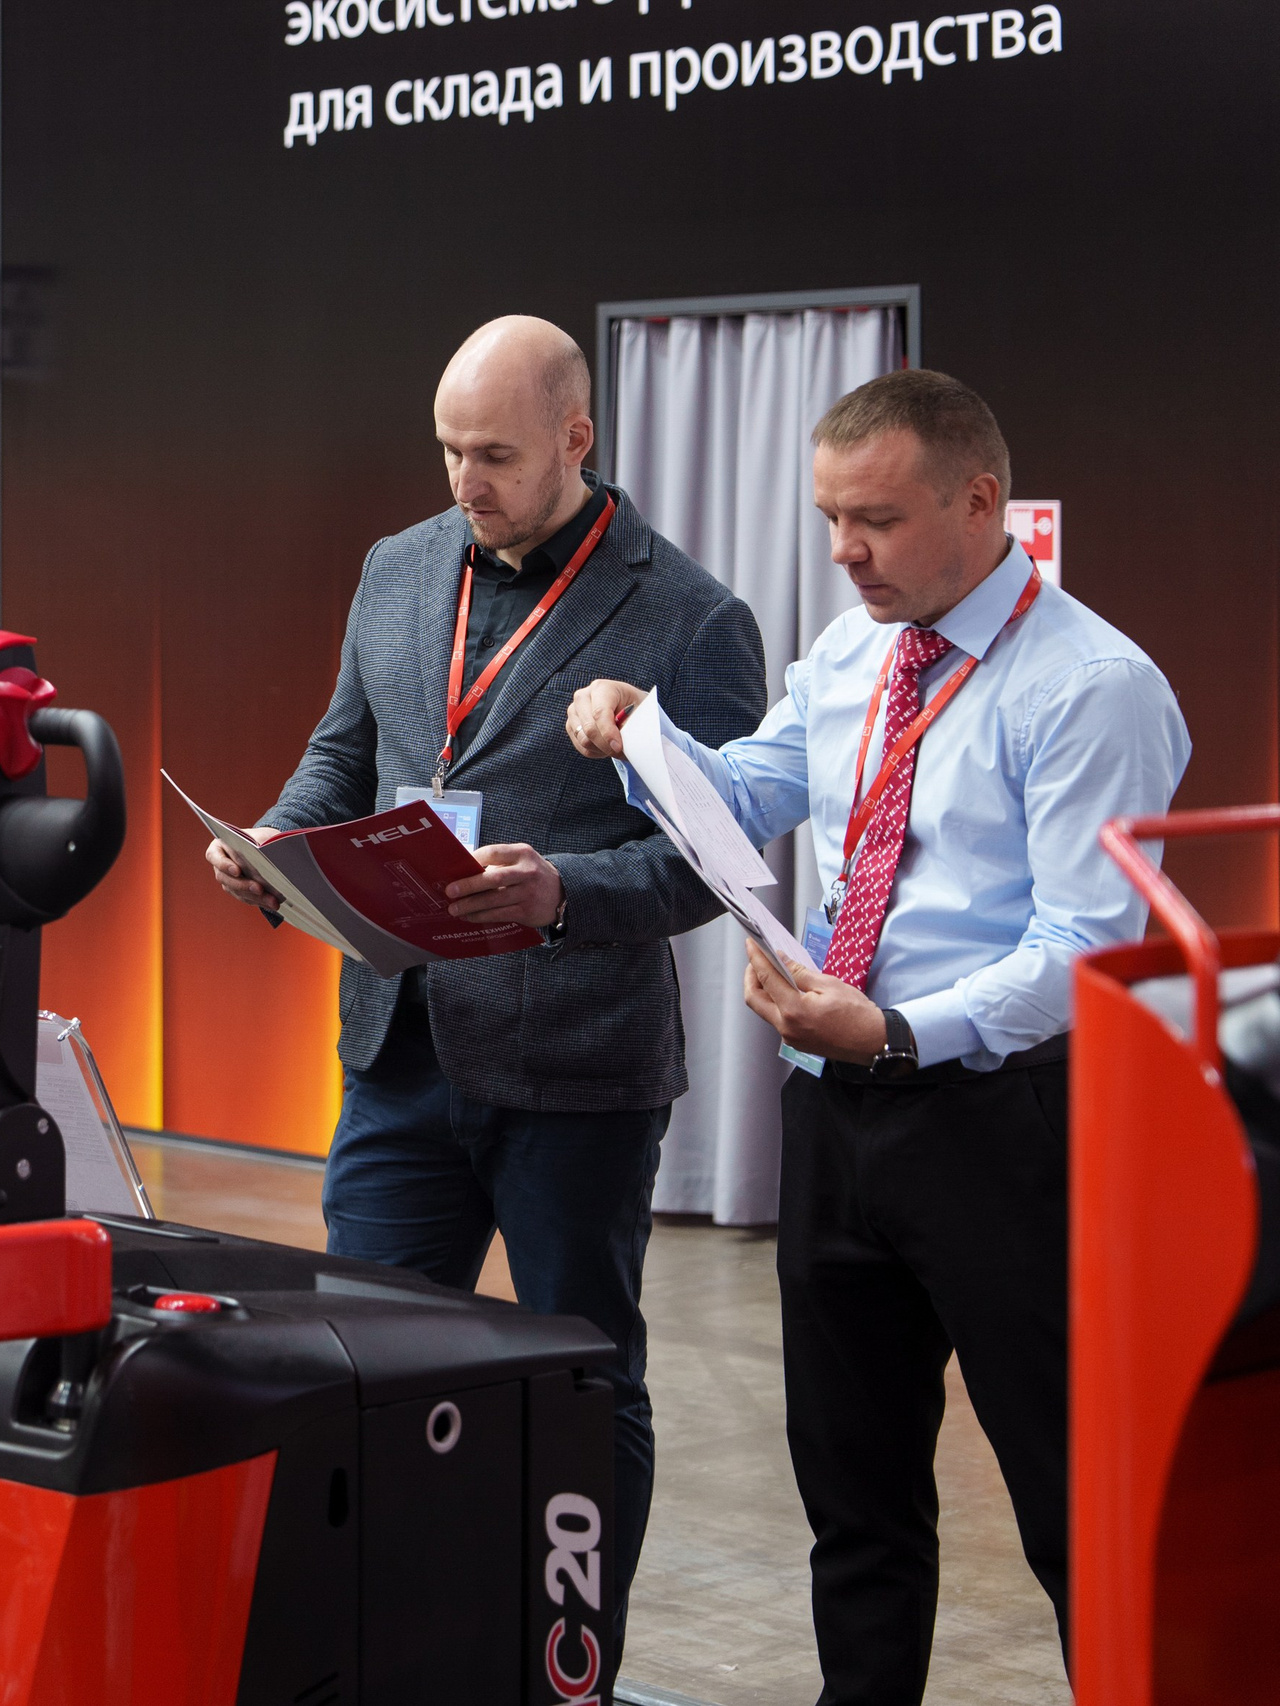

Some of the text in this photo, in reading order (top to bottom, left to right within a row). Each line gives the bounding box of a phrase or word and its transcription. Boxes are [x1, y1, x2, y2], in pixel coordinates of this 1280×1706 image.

[284, 5, 1063, 148] для склада и производства
[892, 779, 912, 800] HELI
[886, 799, 905, 821] HELI
[350, 817, 433, 849] HELI
[432, 922, 519, 941] СКЛАДСКАЯ ТЕХНИКА
